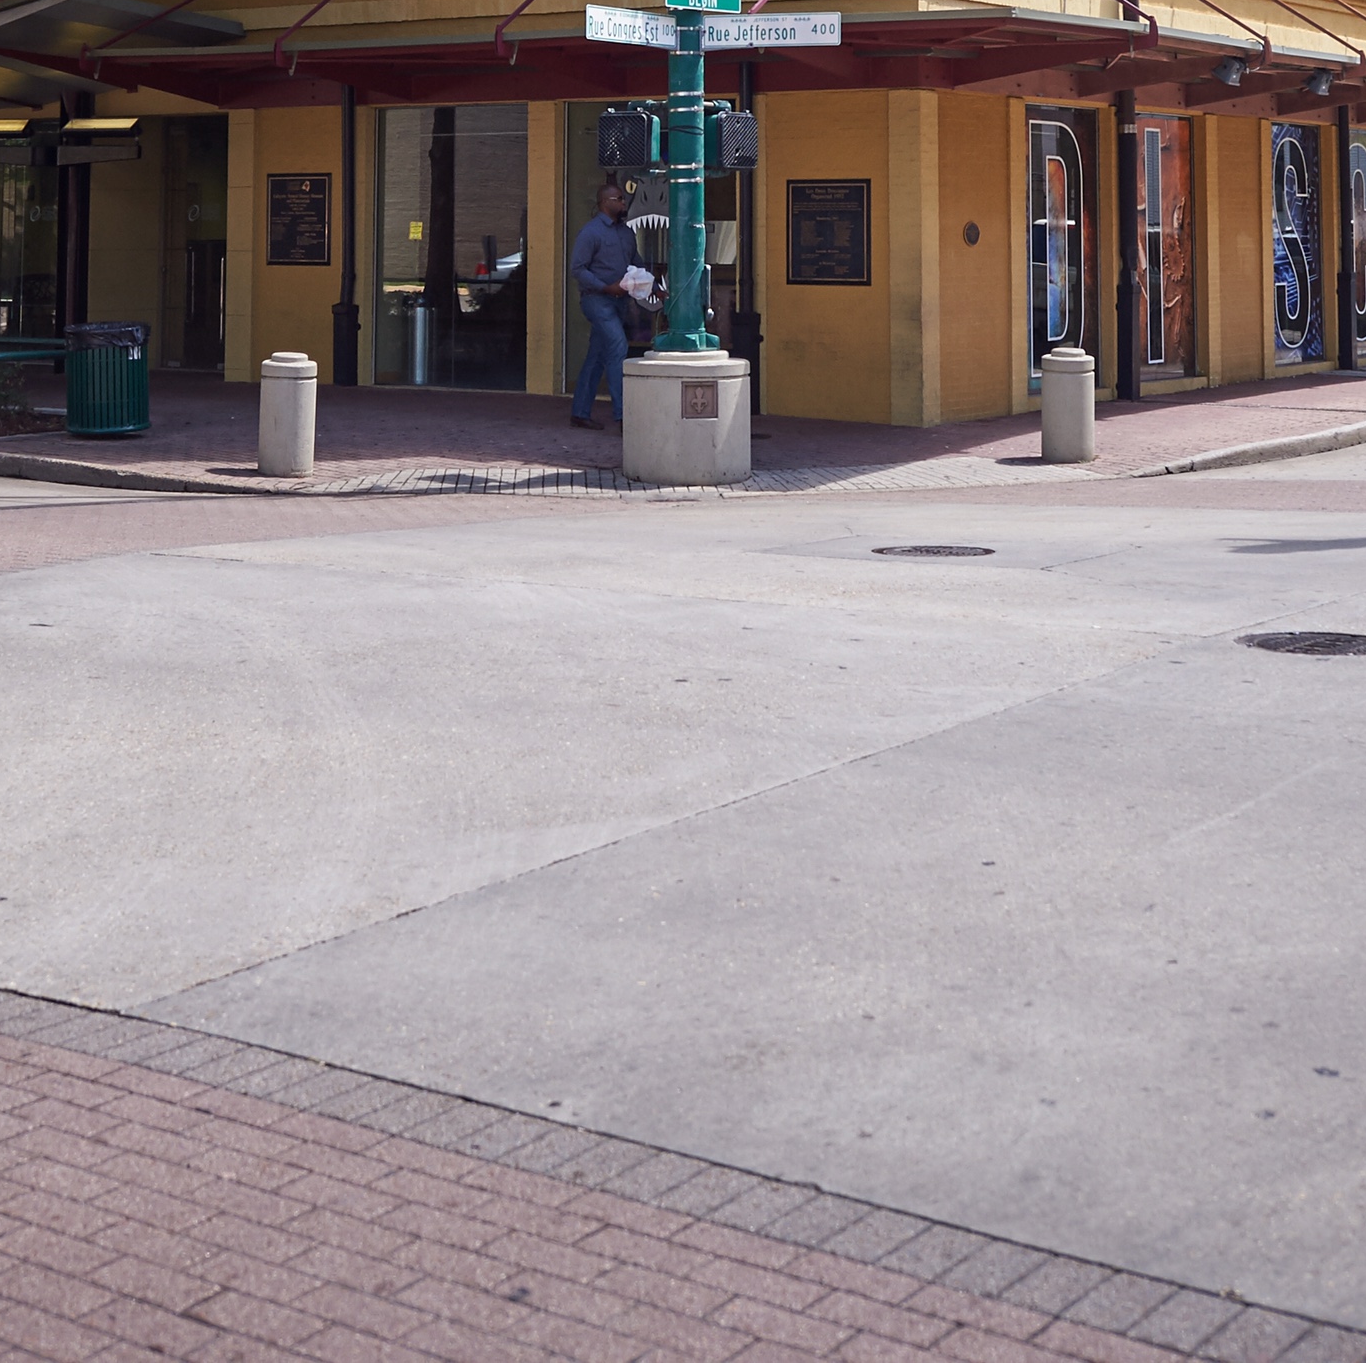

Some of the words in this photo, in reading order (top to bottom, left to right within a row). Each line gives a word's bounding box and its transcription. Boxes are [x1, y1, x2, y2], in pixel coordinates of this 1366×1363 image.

[588, 15, 604, 36] Rue
[645, 22, 659, 42] Est
[662, 24, 675, 37] 100
[708, 26, 730, 41] Rue
[734, 25, 796, 41] Jefferson
[811, 23, 835, 35] 400
